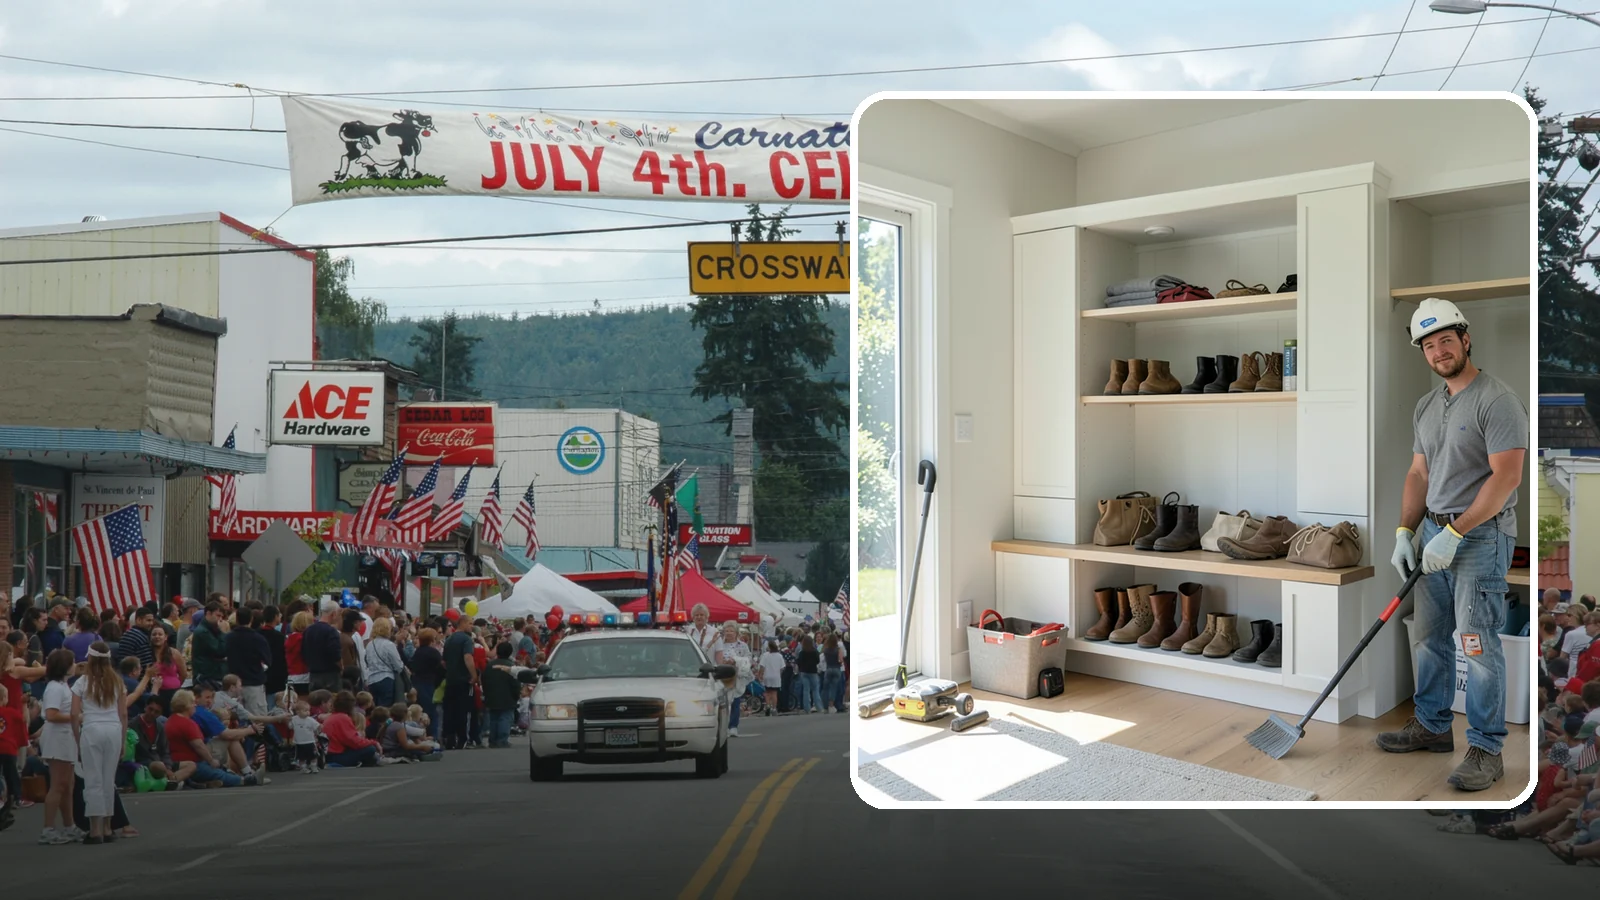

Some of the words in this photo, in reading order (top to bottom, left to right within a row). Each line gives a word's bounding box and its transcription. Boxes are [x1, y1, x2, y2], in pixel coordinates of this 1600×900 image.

[480, 139, 605, 192] JULY
[632, 149, 747, 198] 4th.
[697, 254, 850, 280] CROSSWA
[282, 380, 373, 420] ACE
[406, 409, 452, 422] CEDAR
[283, 421, 371, 436] Hardware
[416, 428, 477, 447] Coca-Cola
[353, 467, 385, 479] Simpl
[83, 485, 93, 494] St.
[95, 485, 124, 494] Vincent
[126, 485, 135, 494] de
[137, 485, 155, 495] Paul
[212, 515, 331, 535] HARDARE
[688, 526, 741, 535] CRNATION
[699, 535, 730, 543] GLASS
